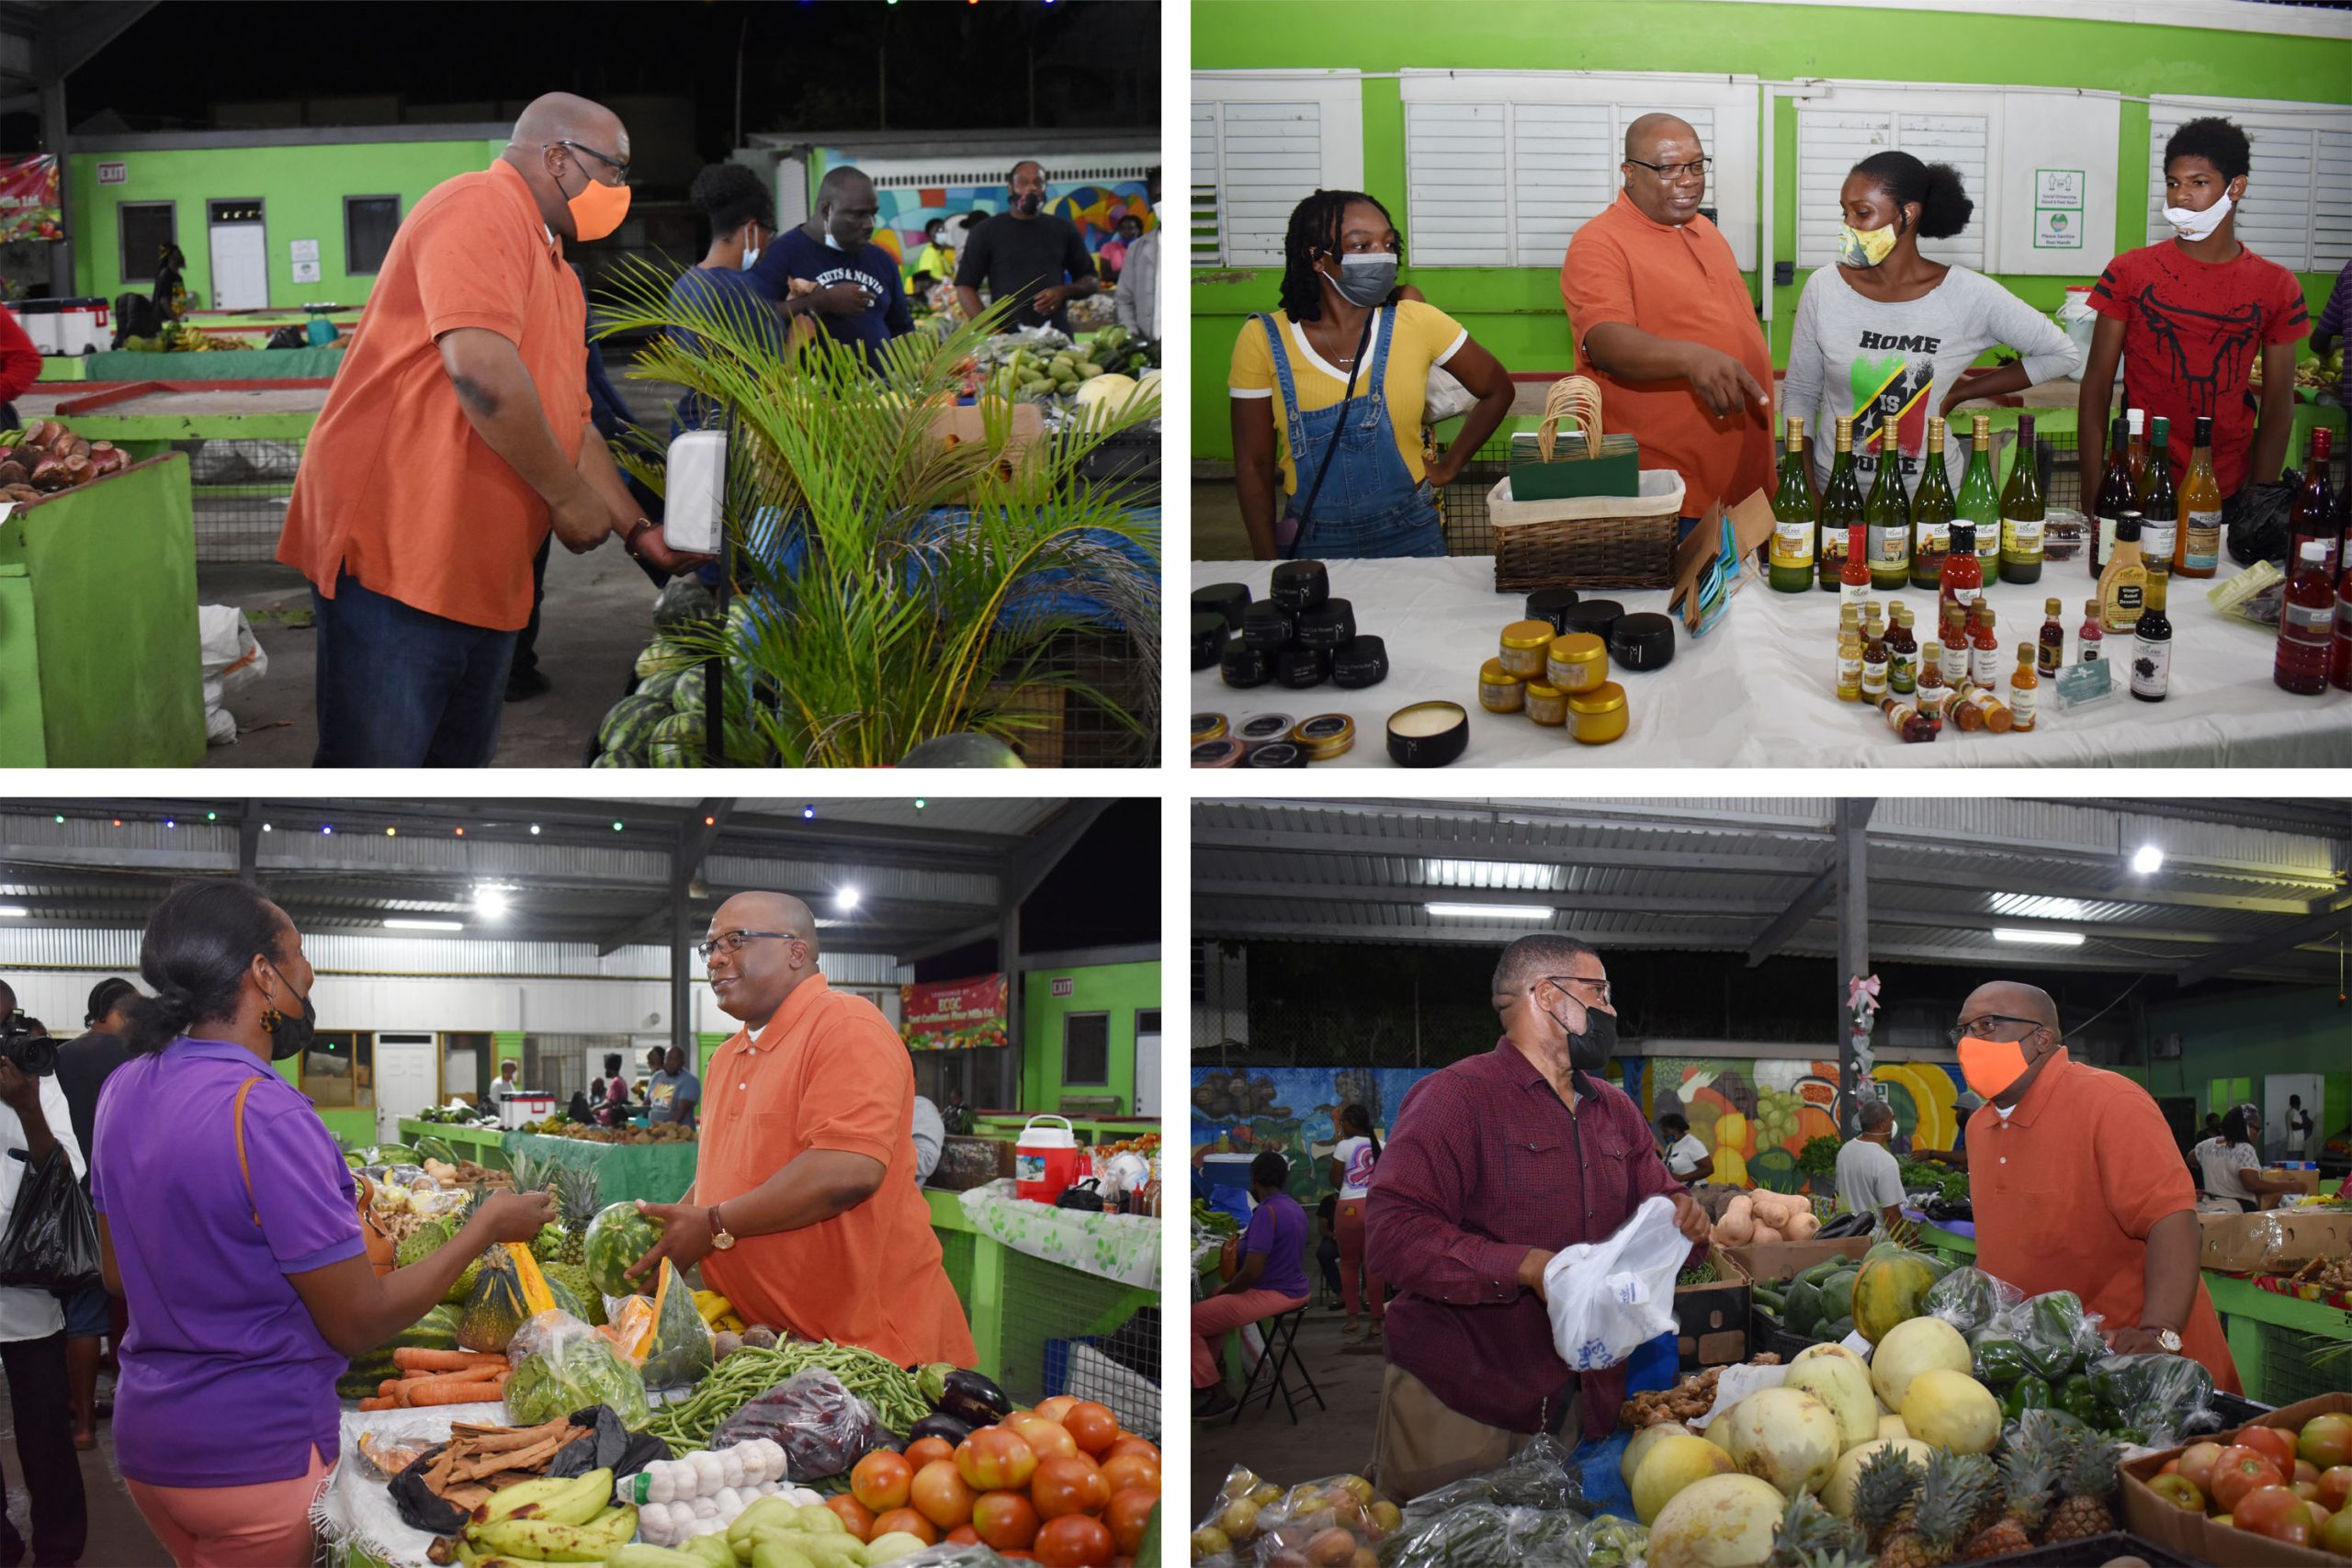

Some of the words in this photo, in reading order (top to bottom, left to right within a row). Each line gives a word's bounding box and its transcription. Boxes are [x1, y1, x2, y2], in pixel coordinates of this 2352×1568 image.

[100, 165, 126, 182] EXIT
[1859, 330, 1941, 355] HOME
[1879, 394, 1901, 412] IS
[1052, 980, 1073, 994] EXIT
